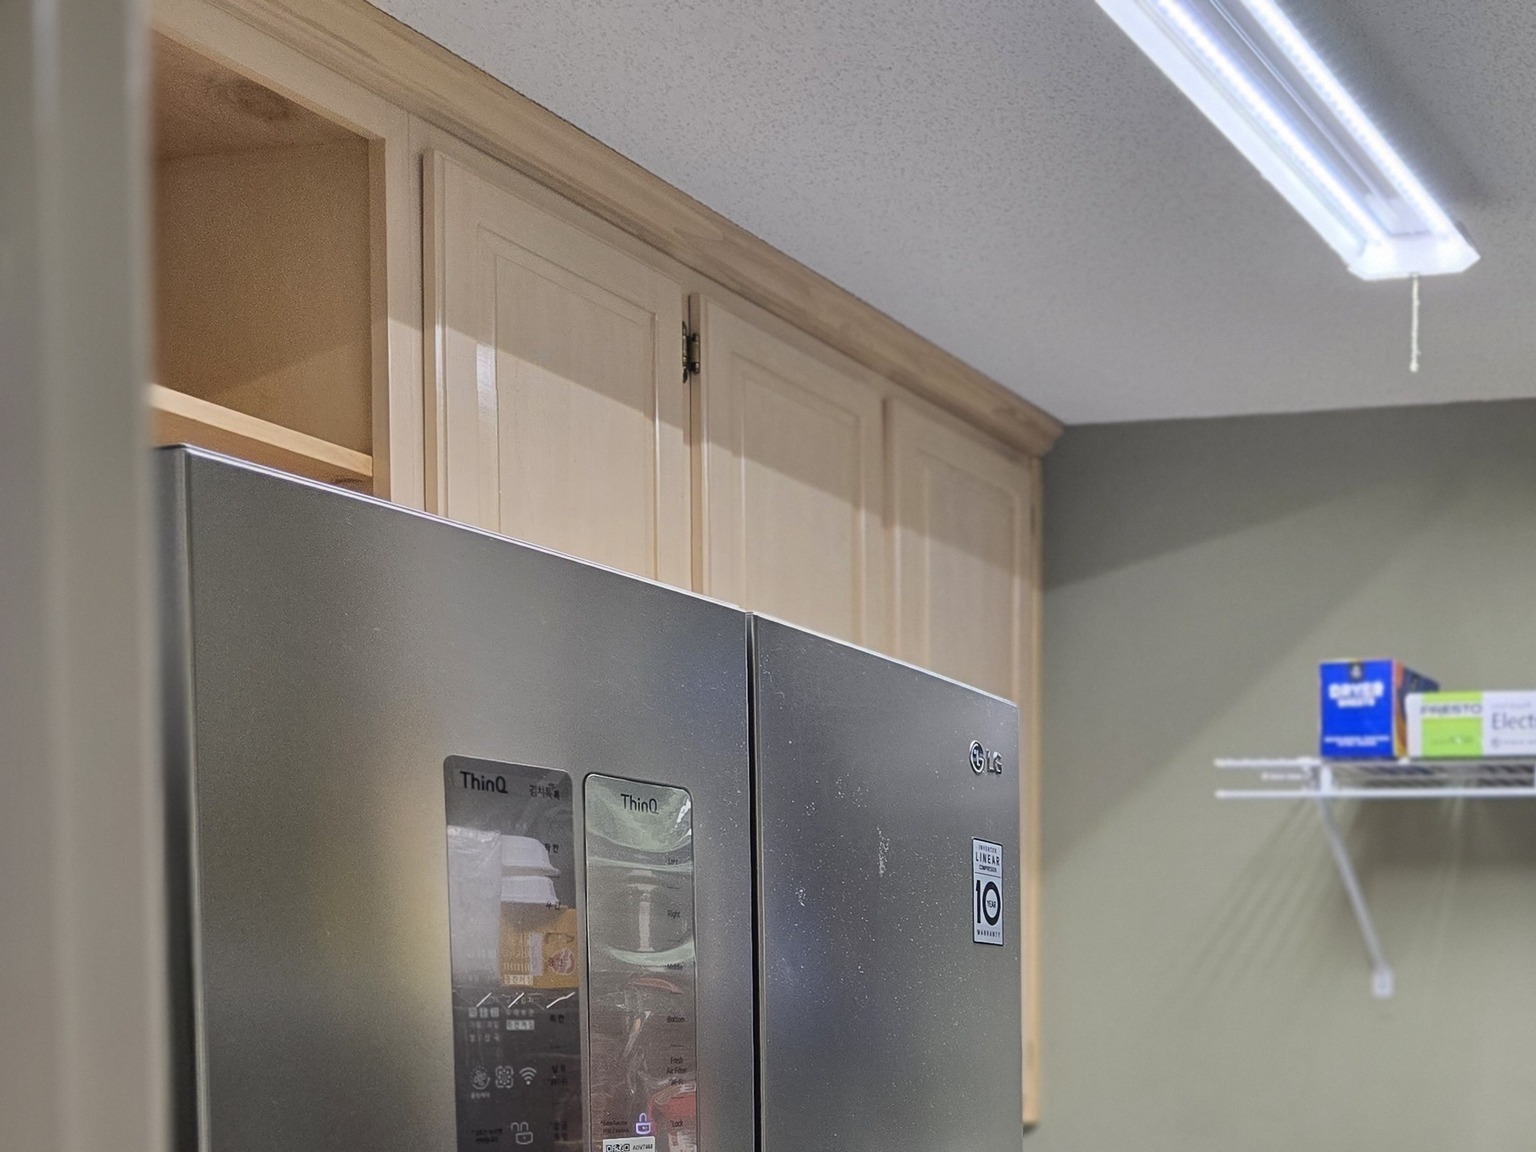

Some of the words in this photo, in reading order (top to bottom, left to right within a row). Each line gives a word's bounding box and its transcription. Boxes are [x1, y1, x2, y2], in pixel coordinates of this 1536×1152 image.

[986, 749, 1002, 774] LG
[460, 771, 508, 794] ThinQ
[620, 793, 659, 815] ThinQ
[975, 851, 1000, 866] LINEAR
[976, 879, 1001, 926] 10
[987, 899, 997, 908] YEAR
[667, 910, 681, 919] Right
[977, 929, 1000, 937] WARRANTY
[667, 1016, 685, 1024] Bottom
[670, 1056, 684, 1064] Fresh
